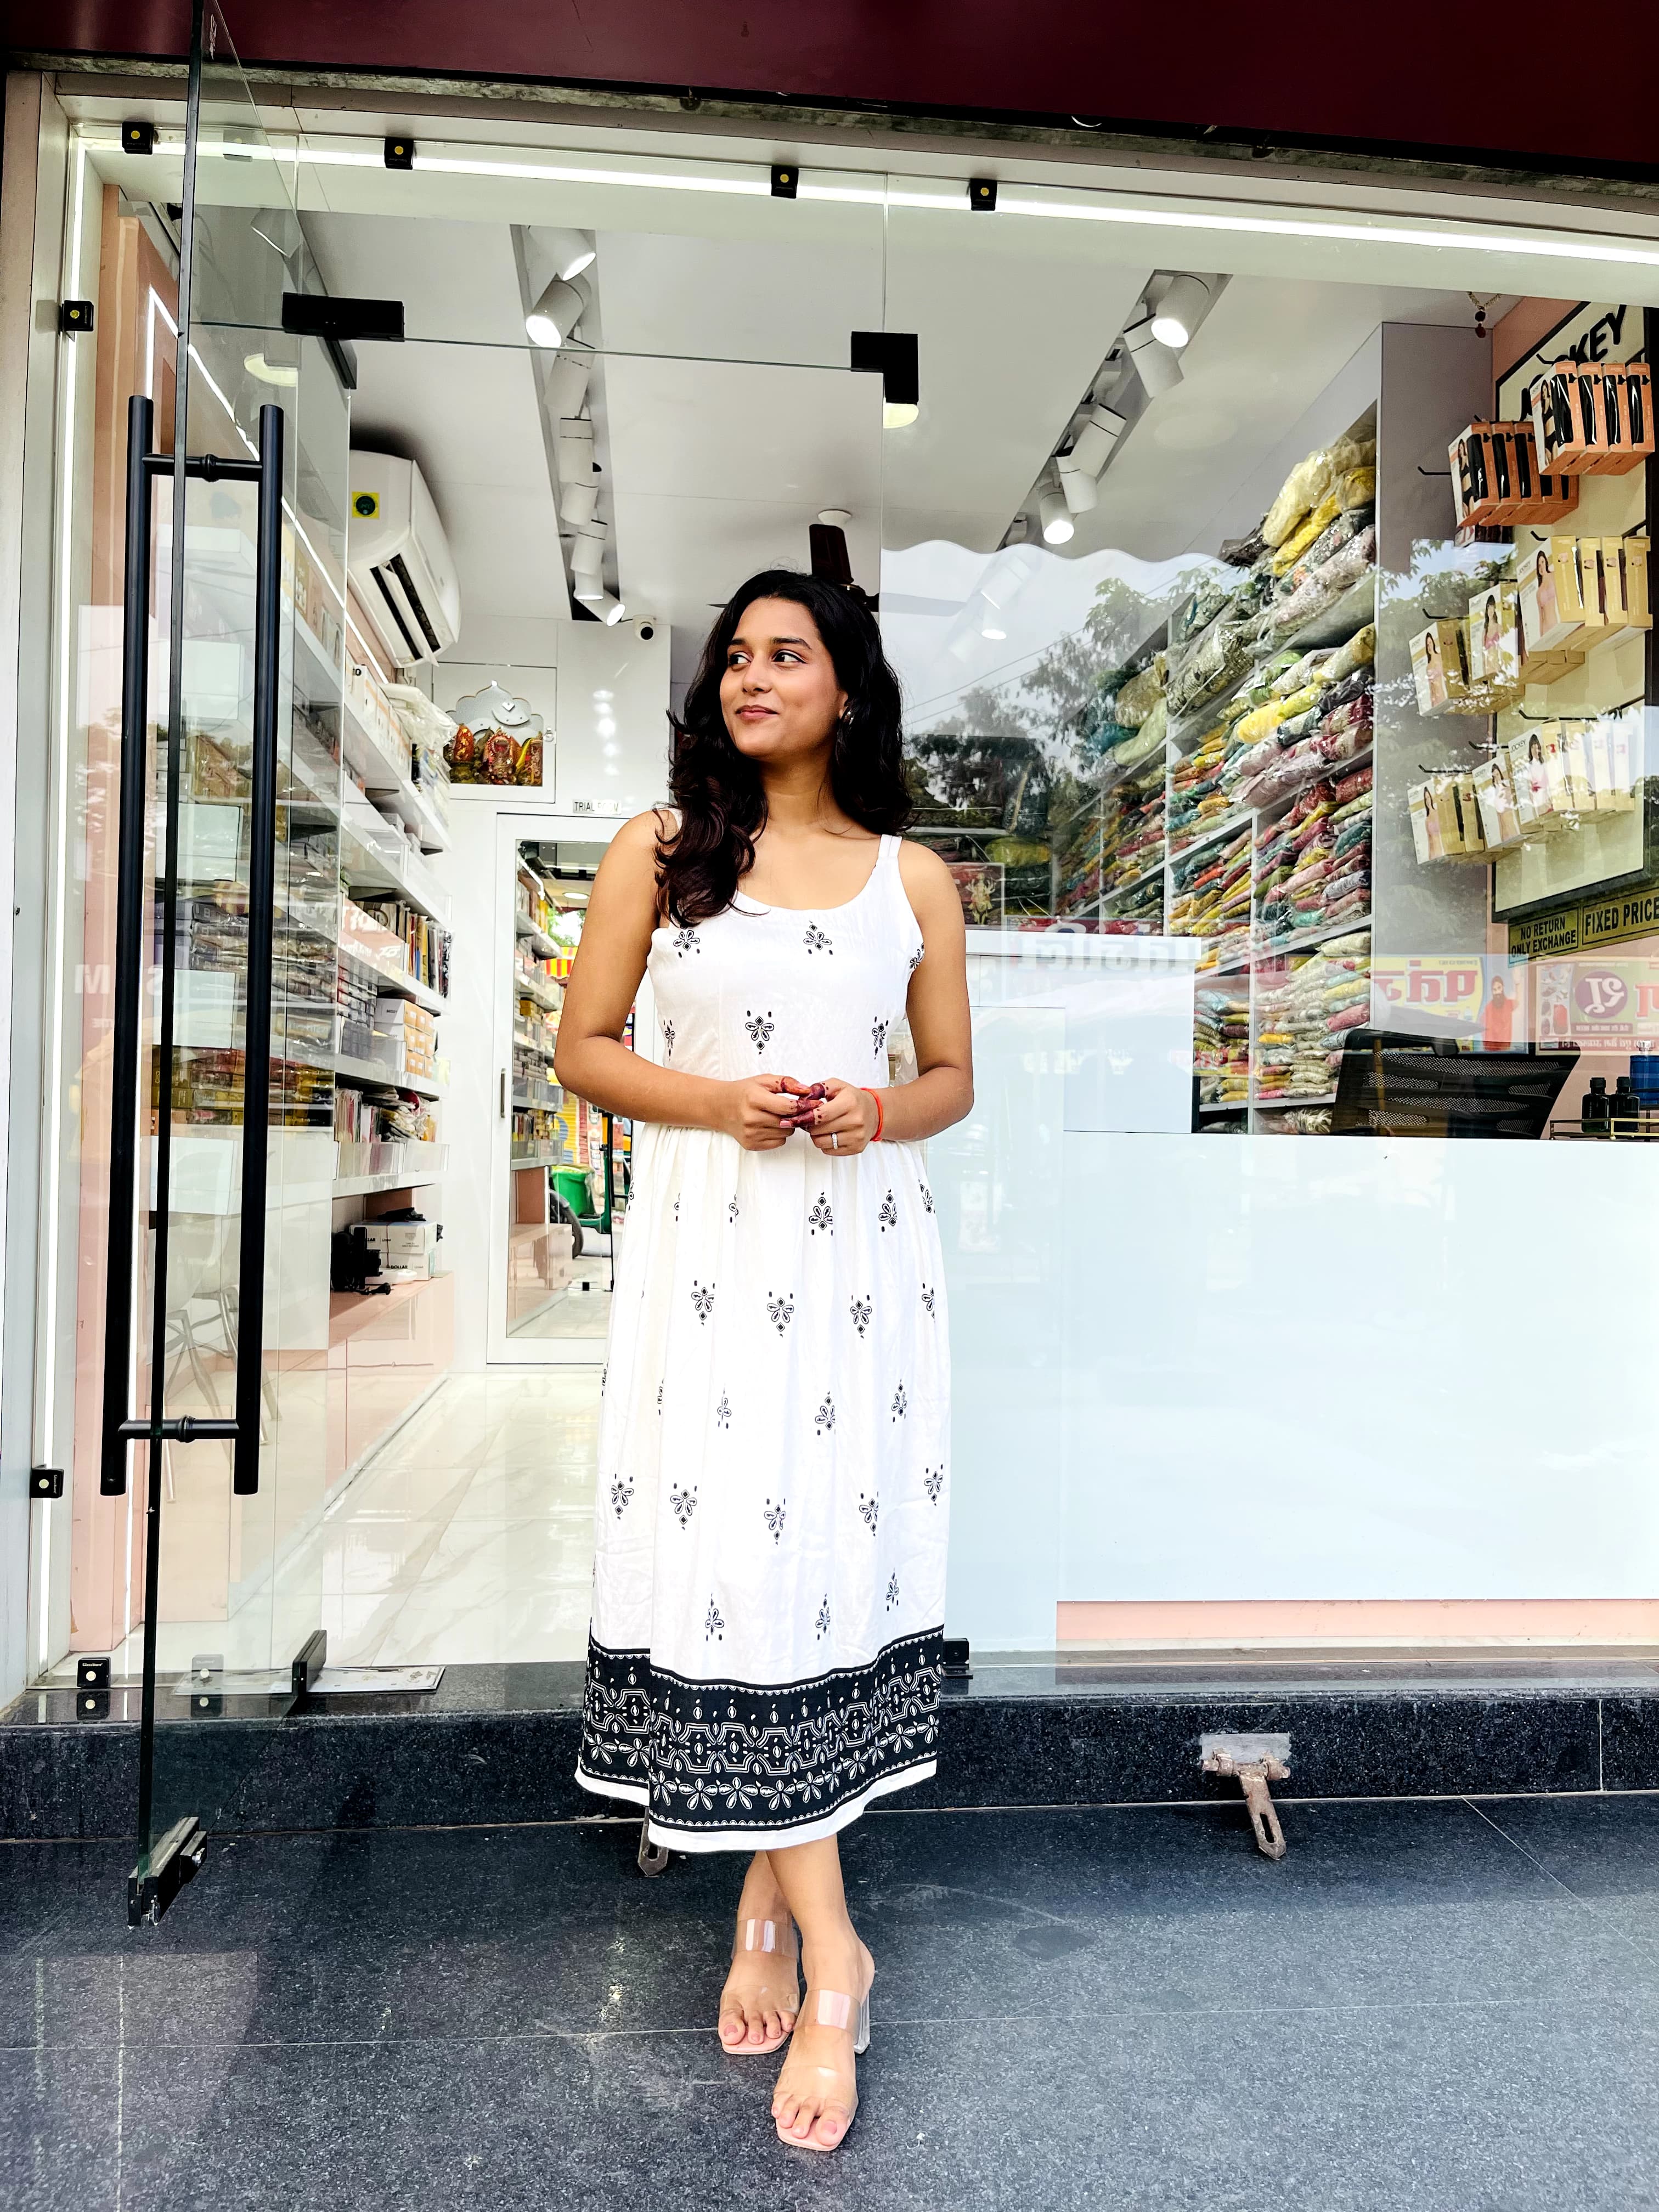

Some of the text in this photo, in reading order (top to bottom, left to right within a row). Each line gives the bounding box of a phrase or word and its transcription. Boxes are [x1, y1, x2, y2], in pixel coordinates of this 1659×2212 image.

[1510, 738, 1526, 753] JOCKEY
[574, 802, 595, 811] TRIAL
[1520, 916, 1565, 940] NO RETURN
[1585, 896, 1659, 936] FIXED PRICE
[1511, 929, 1576, 957] ONLY EXCHANGE
